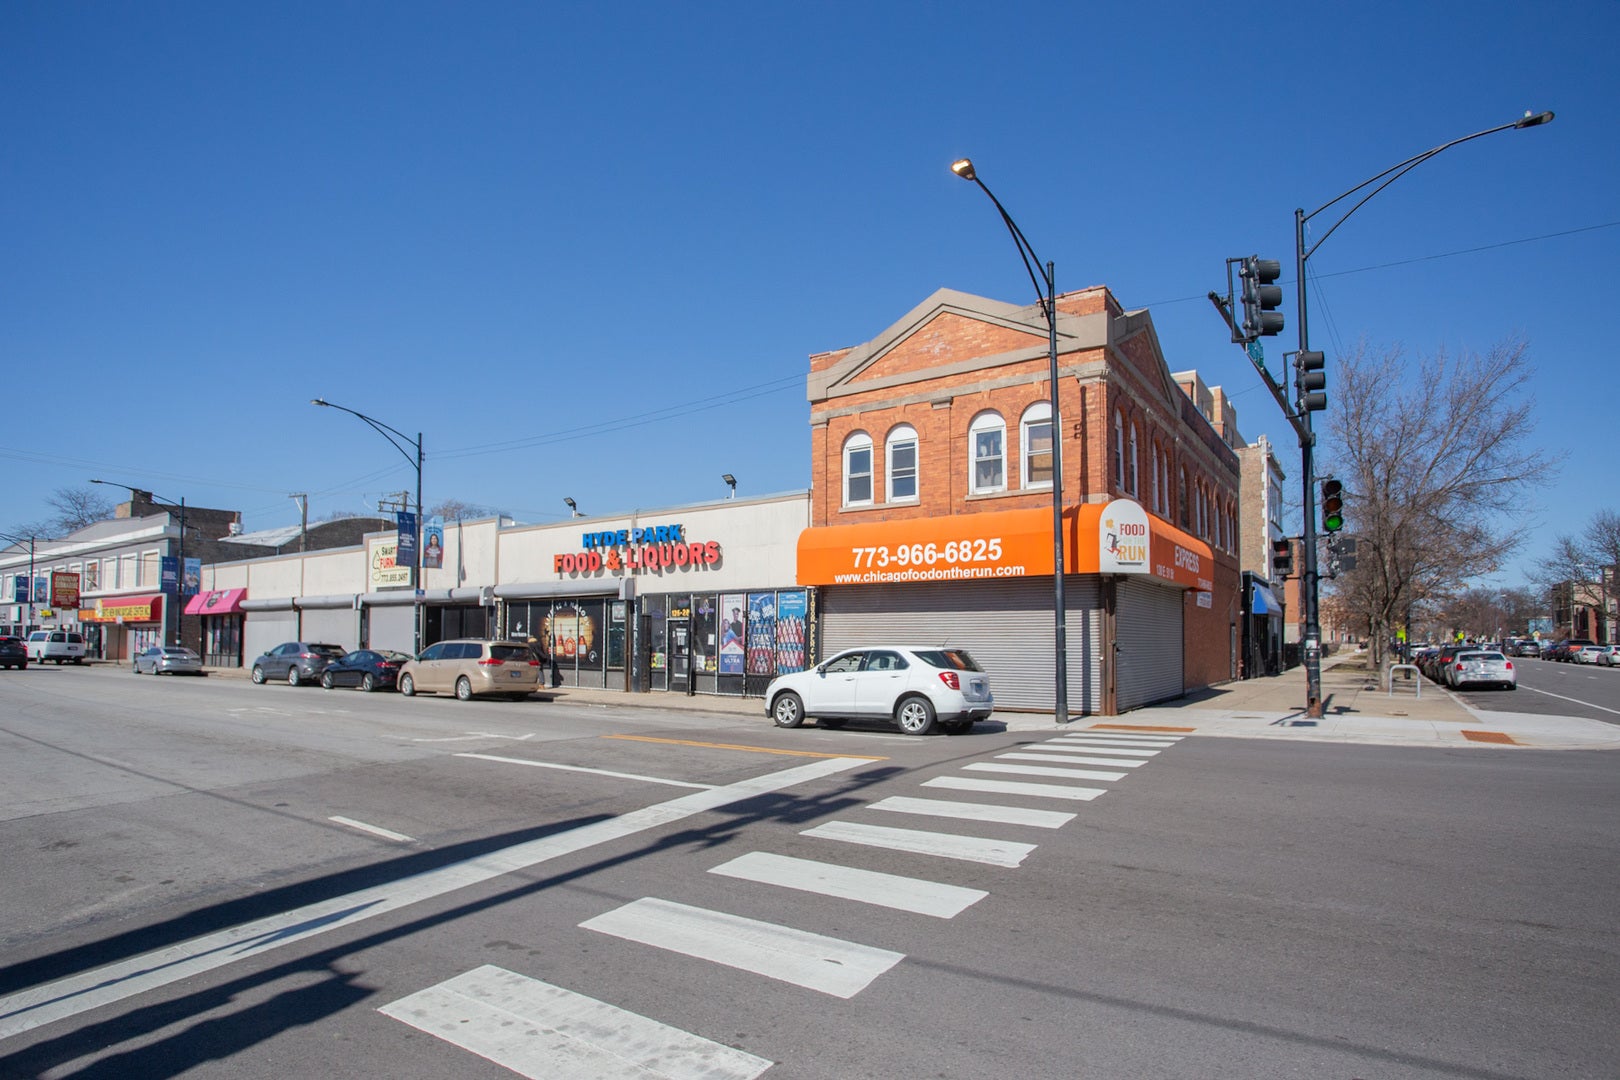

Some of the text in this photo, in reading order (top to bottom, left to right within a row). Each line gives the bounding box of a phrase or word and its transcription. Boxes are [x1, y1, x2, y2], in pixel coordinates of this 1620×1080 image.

[583, 524, 681, 548] HYDE PARK
[1120, 523, 1145, 537] FOOD
[554, 541, 719, 573] FOOD & LIQUORS
[852, 537, 1002, 568] 773-966-6825
[1120, 545, 1146, 561] RUN
[1175, 545, 1200, 573] EXPRESS
[835, 565, 1025, 583] www.chicagofoodontherun.com
